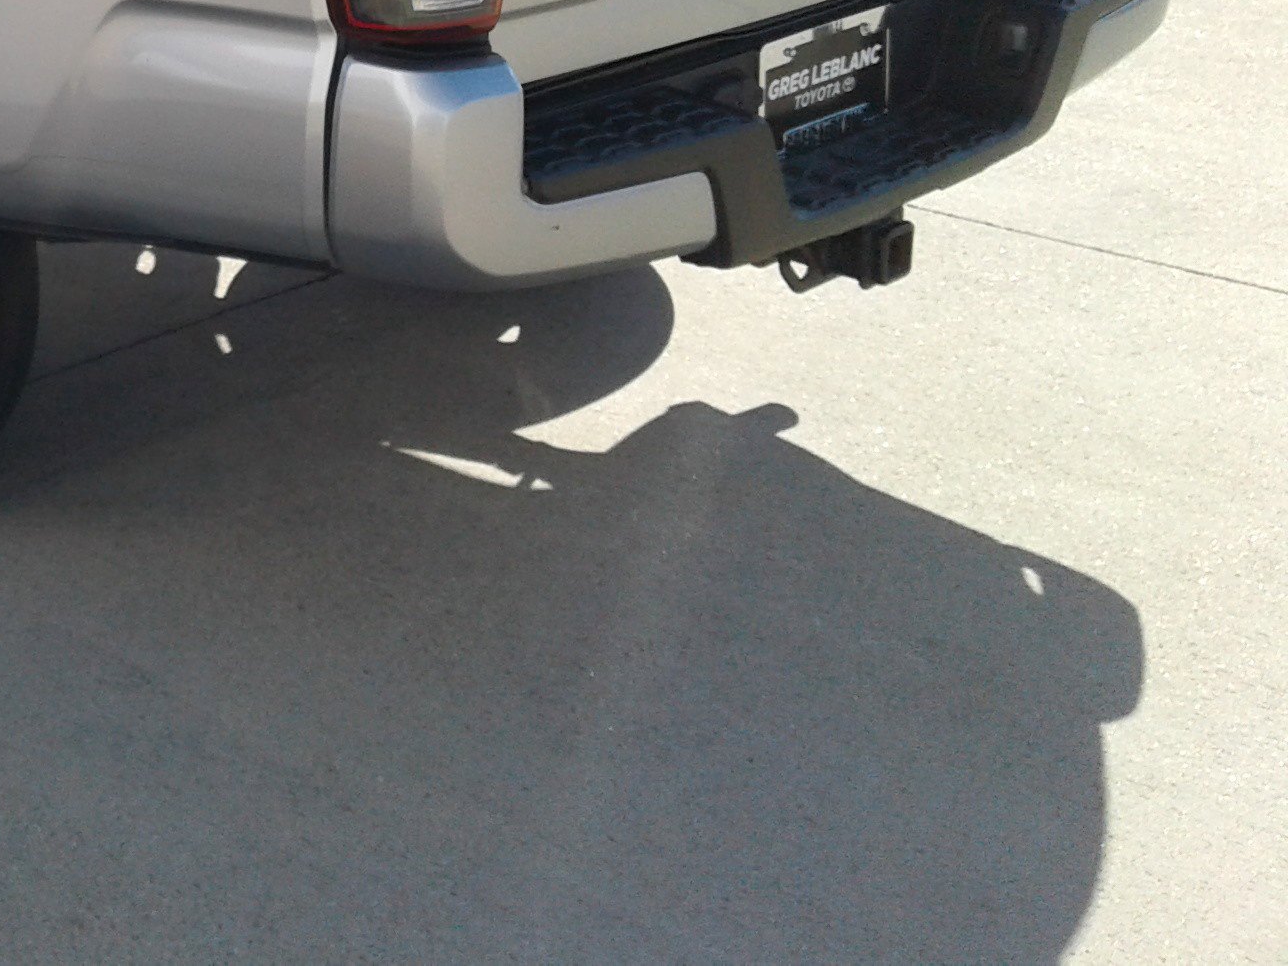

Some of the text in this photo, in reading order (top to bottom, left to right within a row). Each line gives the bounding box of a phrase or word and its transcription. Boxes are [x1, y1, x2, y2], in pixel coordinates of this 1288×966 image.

[768, 43, 882, 100] GREG LEBLANC
[794, 81, 841, 110] TOYOTA
